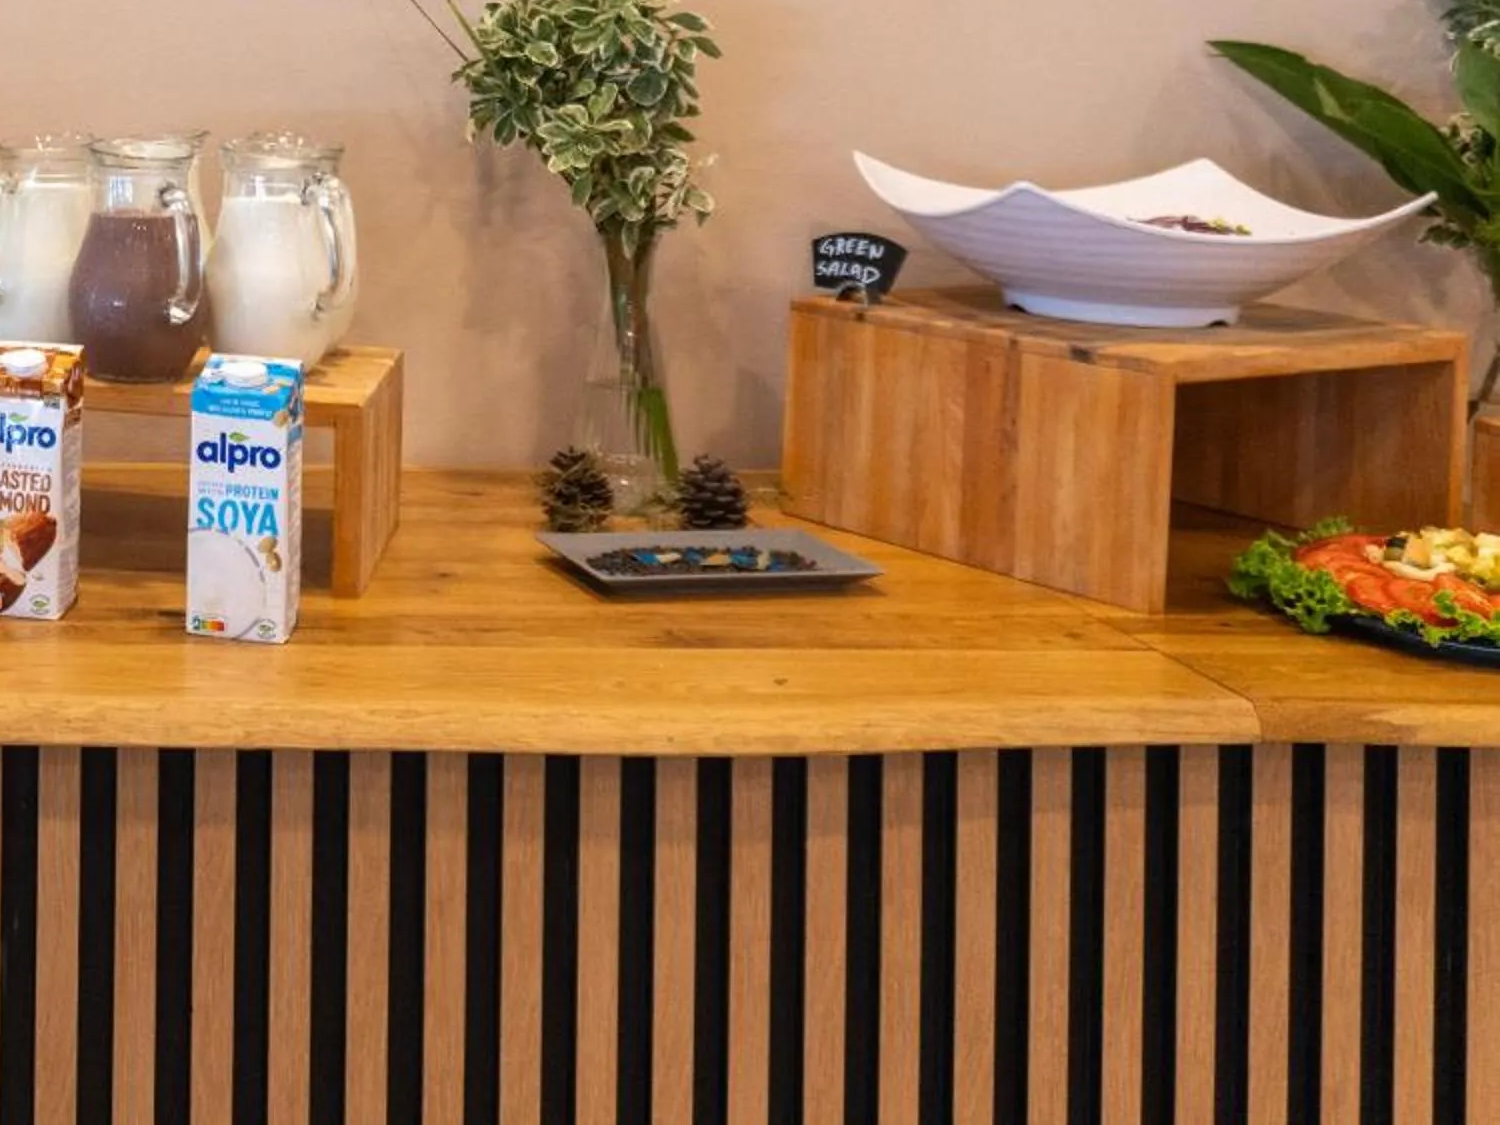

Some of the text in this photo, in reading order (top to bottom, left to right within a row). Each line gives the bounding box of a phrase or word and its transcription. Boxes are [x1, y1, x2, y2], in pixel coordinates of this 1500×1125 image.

[820, 237, 885, 260] GREEN
[816, 261, 881, 284] SALAD
[196, 432, 281, 473] alpro
[225, 483, 279, 500] PROTEIN
[196, 496, 279, 537] SOYA
